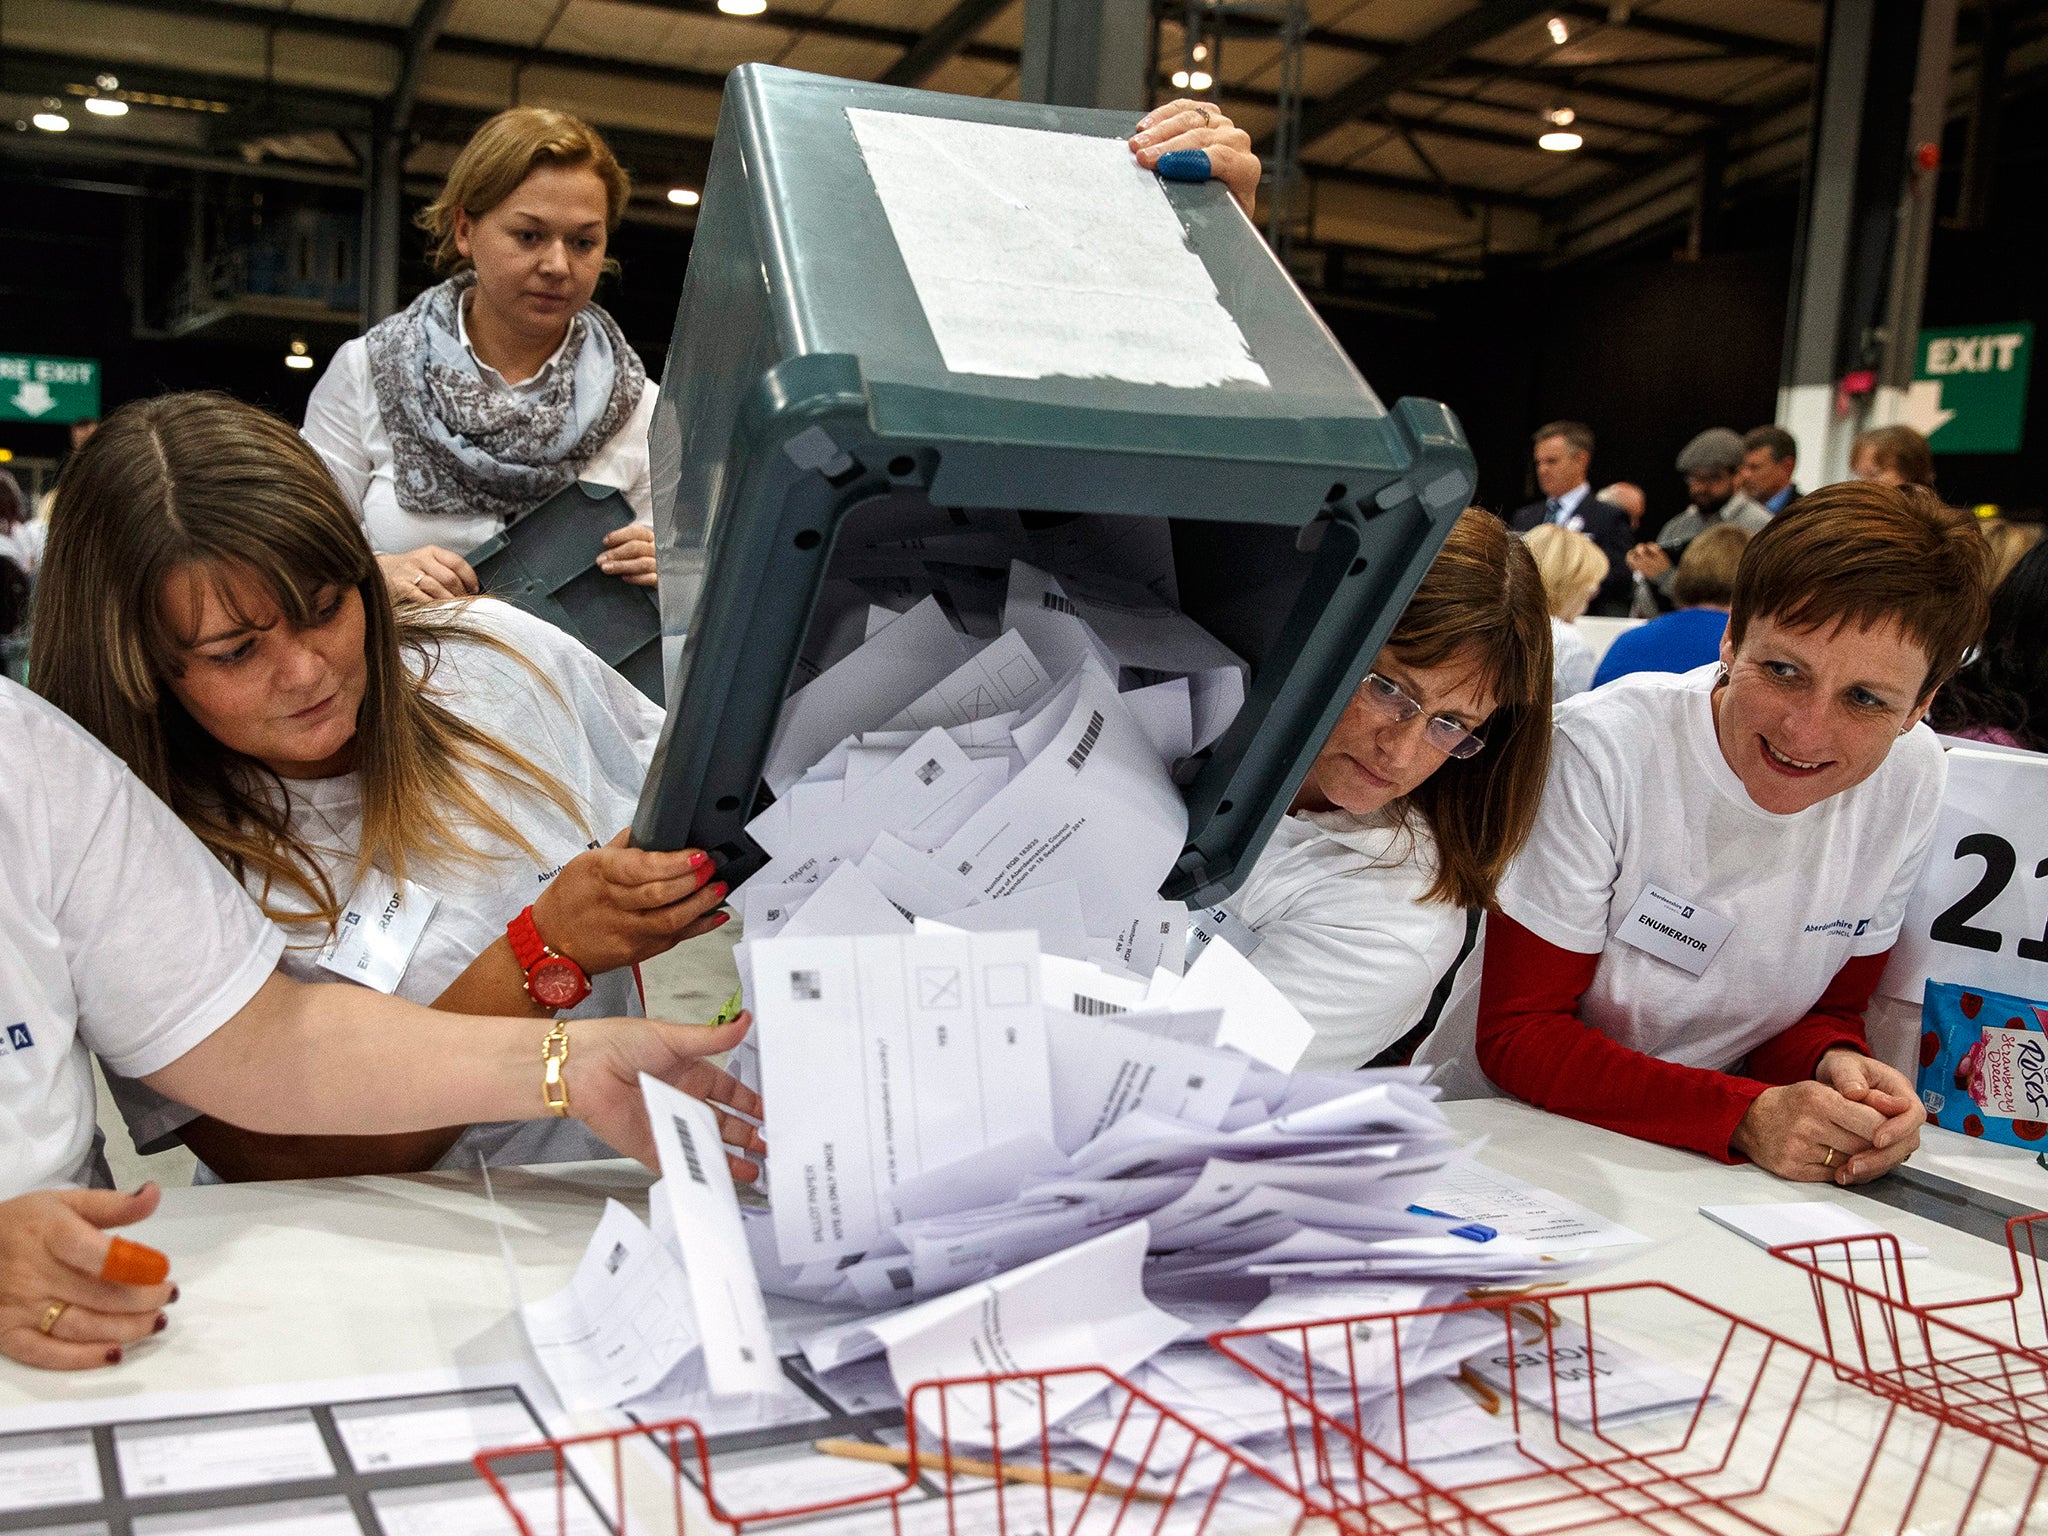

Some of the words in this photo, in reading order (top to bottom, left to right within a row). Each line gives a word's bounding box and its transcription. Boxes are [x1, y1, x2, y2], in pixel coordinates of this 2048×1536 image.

[34, 361, 93, 385] EXIT
[1926, 333, 2024, 375] EXIT
[1011, 843, 1049, 880] Aberdeenshire
[1048, 823, 1070, 844] Council
[1043, 831, 1072, 858] September
[1071, 818, 1086, 832] 2014
[789, 858, 817, 882] PAPER
[1650, 891, 1683, 910] Aberdeenshire
[1638, 914, 1708, 952] ENUMERATOR
[1987, 1049, 2002, 1099] Dream
[1998, 1033, 2016, 1114] Strawberry
[2017, 1039, 2048, 1118] Roses
